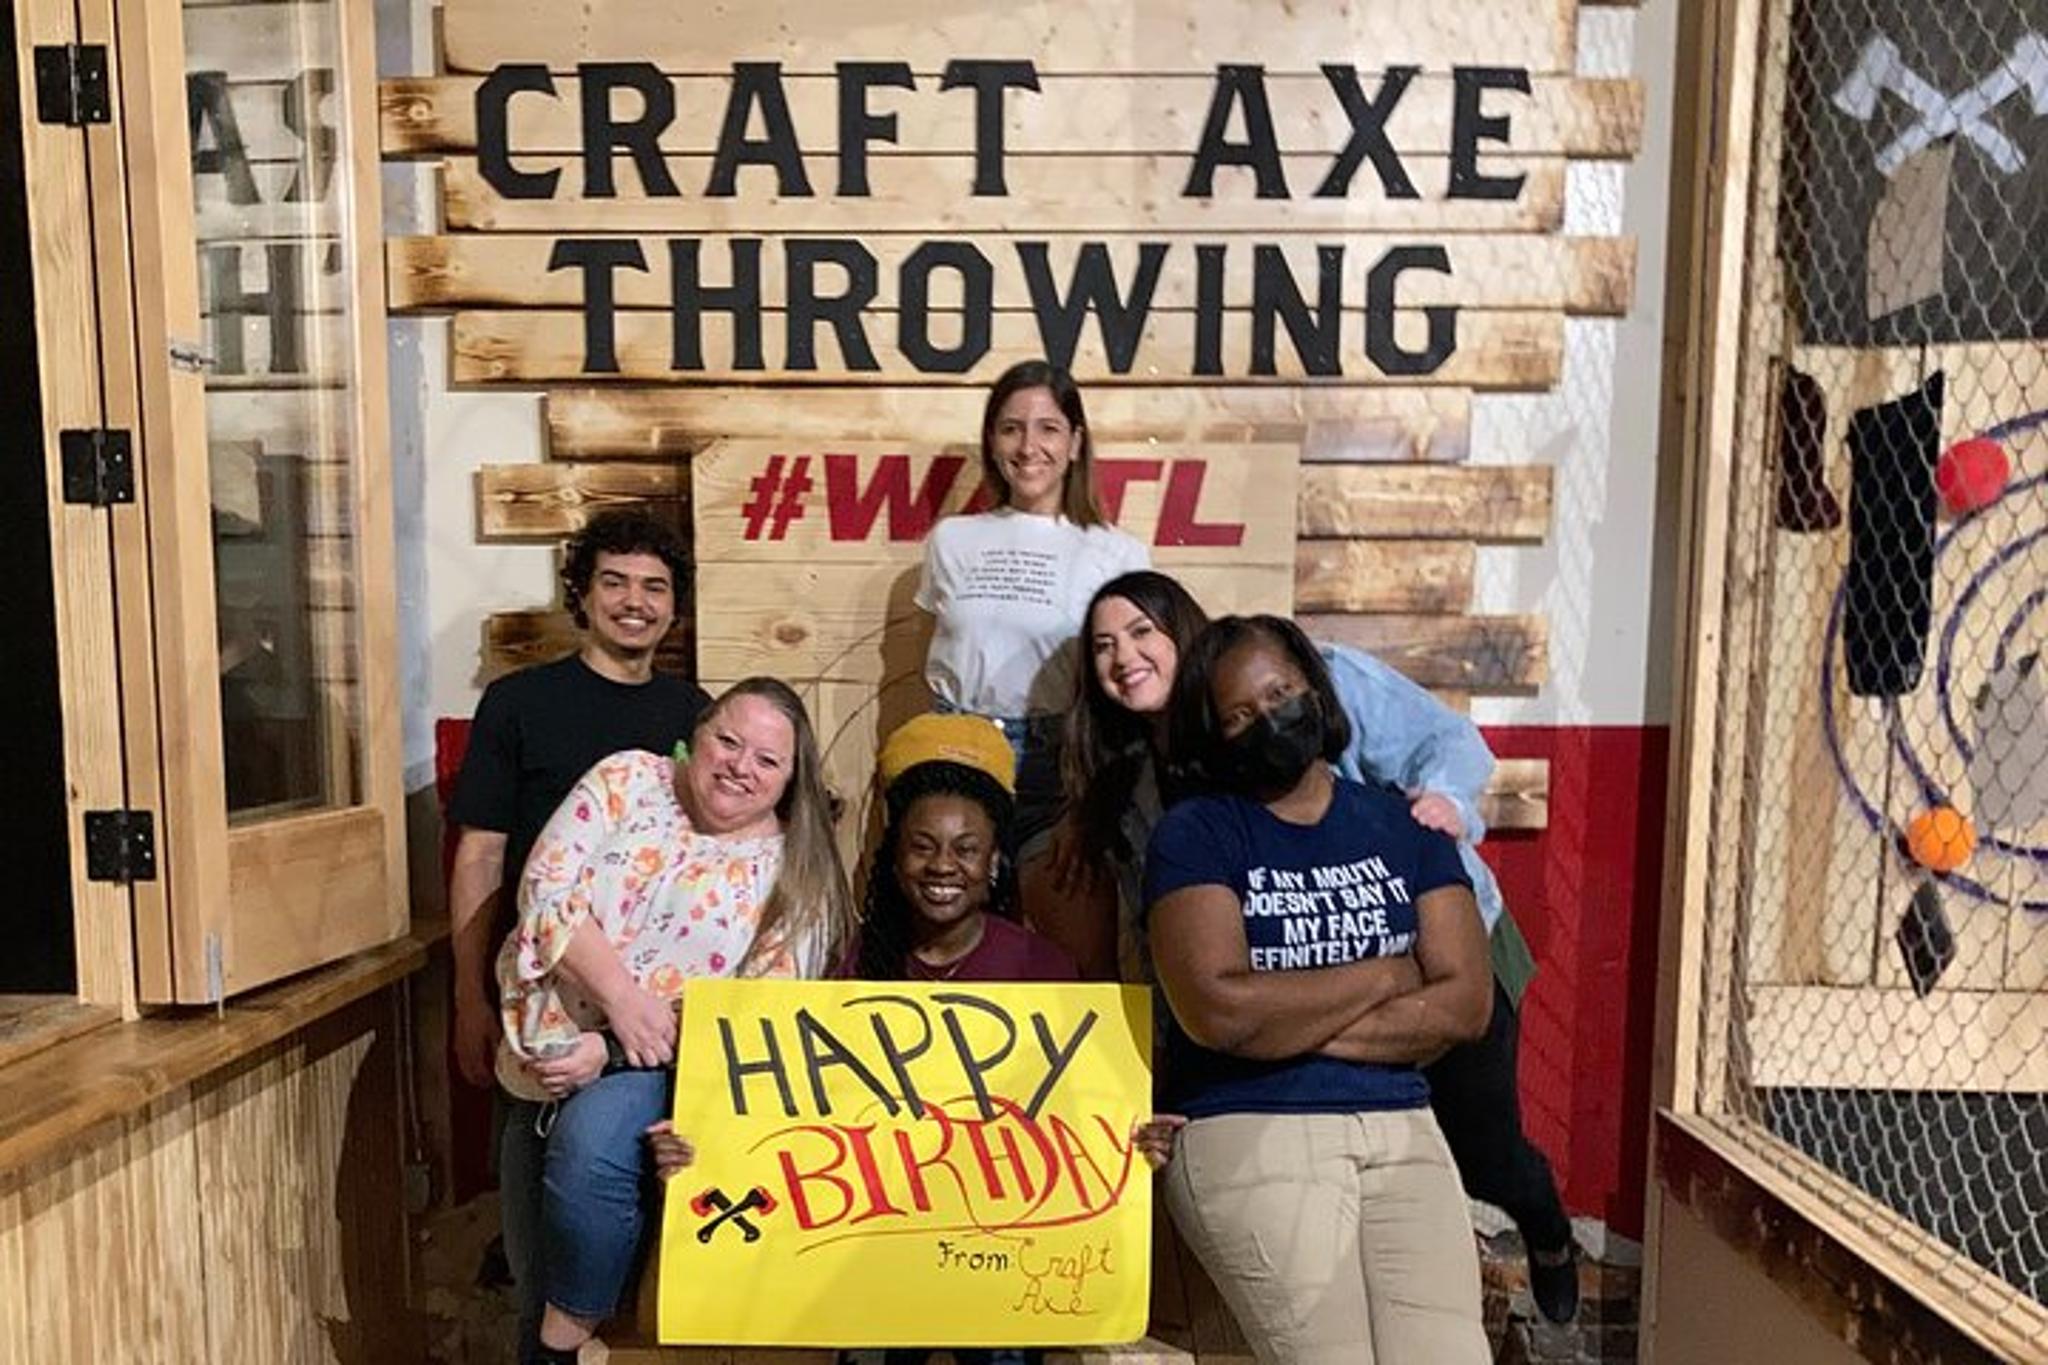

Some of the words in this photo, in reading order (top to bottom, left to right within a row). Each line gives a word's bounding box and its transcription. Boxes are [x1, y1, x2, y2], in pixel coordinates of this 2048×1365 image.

[475, 60, 1042, 199] CRAFT
[1182, 63, 1533, 200] AXE
[546, 238, 1461, 378] THROWING
[741, 454, 1246, 547] #WTL
[1248, 866, 1267, 891] IF
[1271, 869, 1305, 891] MY
[1311, 855, 1391, 890] MOUTH
[1340, 881, 1387, 910] SAY
[1387, 877, 1411, 903] IT
[1250, 939, 1370, 972] EFINITELY
[1283, 917, 1320, 945] MY
[1327, 908, 1391, 940] FACE
[717, 993, 1099, 1122] HAPPY
[748, 1093, 1139, 1233] BIRTHDAY
[938, 1241, 1009, 1272] From
[1018, 1237, 1116, 1295] Craft
[1012, 1276, 1100, 1316] Axe
